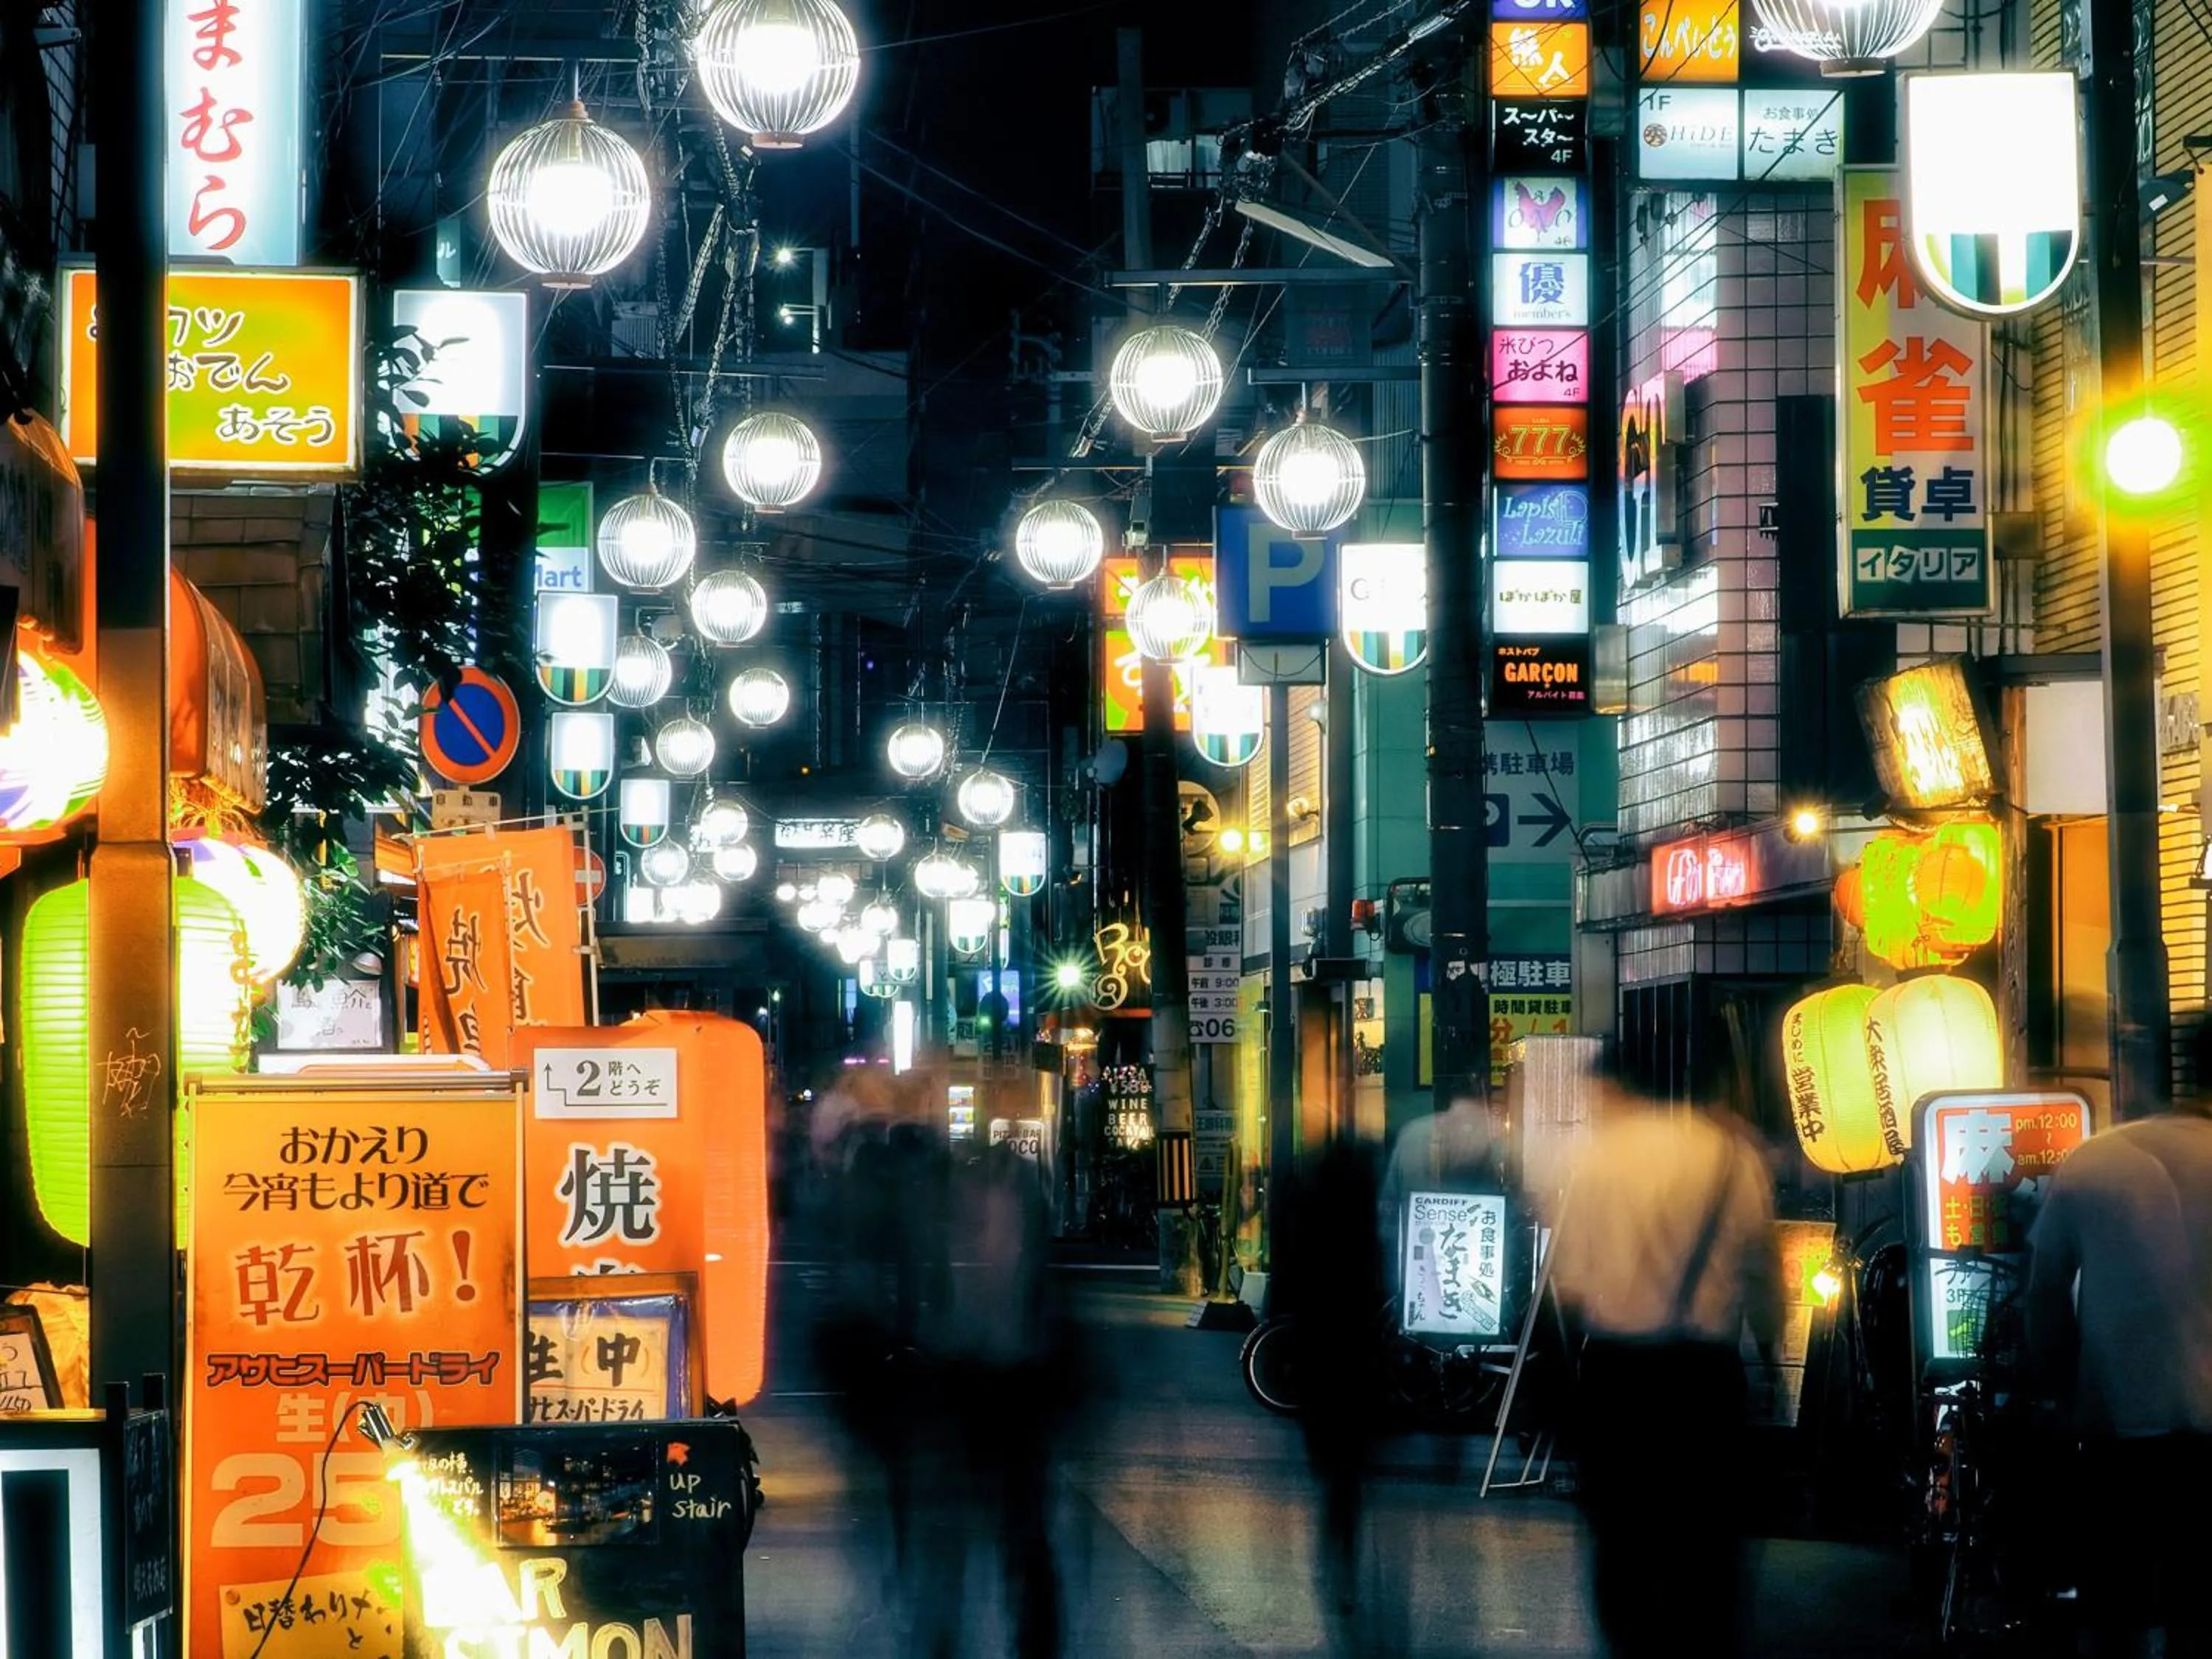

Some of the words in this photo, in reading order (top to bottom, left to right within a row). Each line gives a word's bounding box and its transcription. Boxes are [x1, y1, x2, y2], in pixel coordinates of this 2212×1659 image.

[1647, 94, 1672, 111] 1F
[1550, 149, 1573, 163] 4F
[1749, 127, 1838, 156] たまき
[1520, 262, 1565, 305] 優
[1508, 359, 1579, 383] およね
[1563, 387, 1580, 397] 4F
[218, 405, 333, 444] あそう
[1509, 424, 1571, 455] 777
[1860, 465, 1977, 522] 貸卓
[1248, 522, 1324, 623] P
[1859, 550, 1978, 580] イタリア
[609, 1079, 661, 1097] どうぞ
[1108, 1098, 1148, 1110] WINE
[1108, 1113, 1147, 1126] BEER
[279, 1127, 429, 1165] おかえり
[223, 1172, 489, 1211] 今宵もより道で
[1415, 1197, 1468, 1206] CARDIFF
[560, 1147, 655, 1277] 焼
[1414, 1206, 1467, 1222] Sense
[206, 1351, 501, 1388] アサヒスーパードライ
